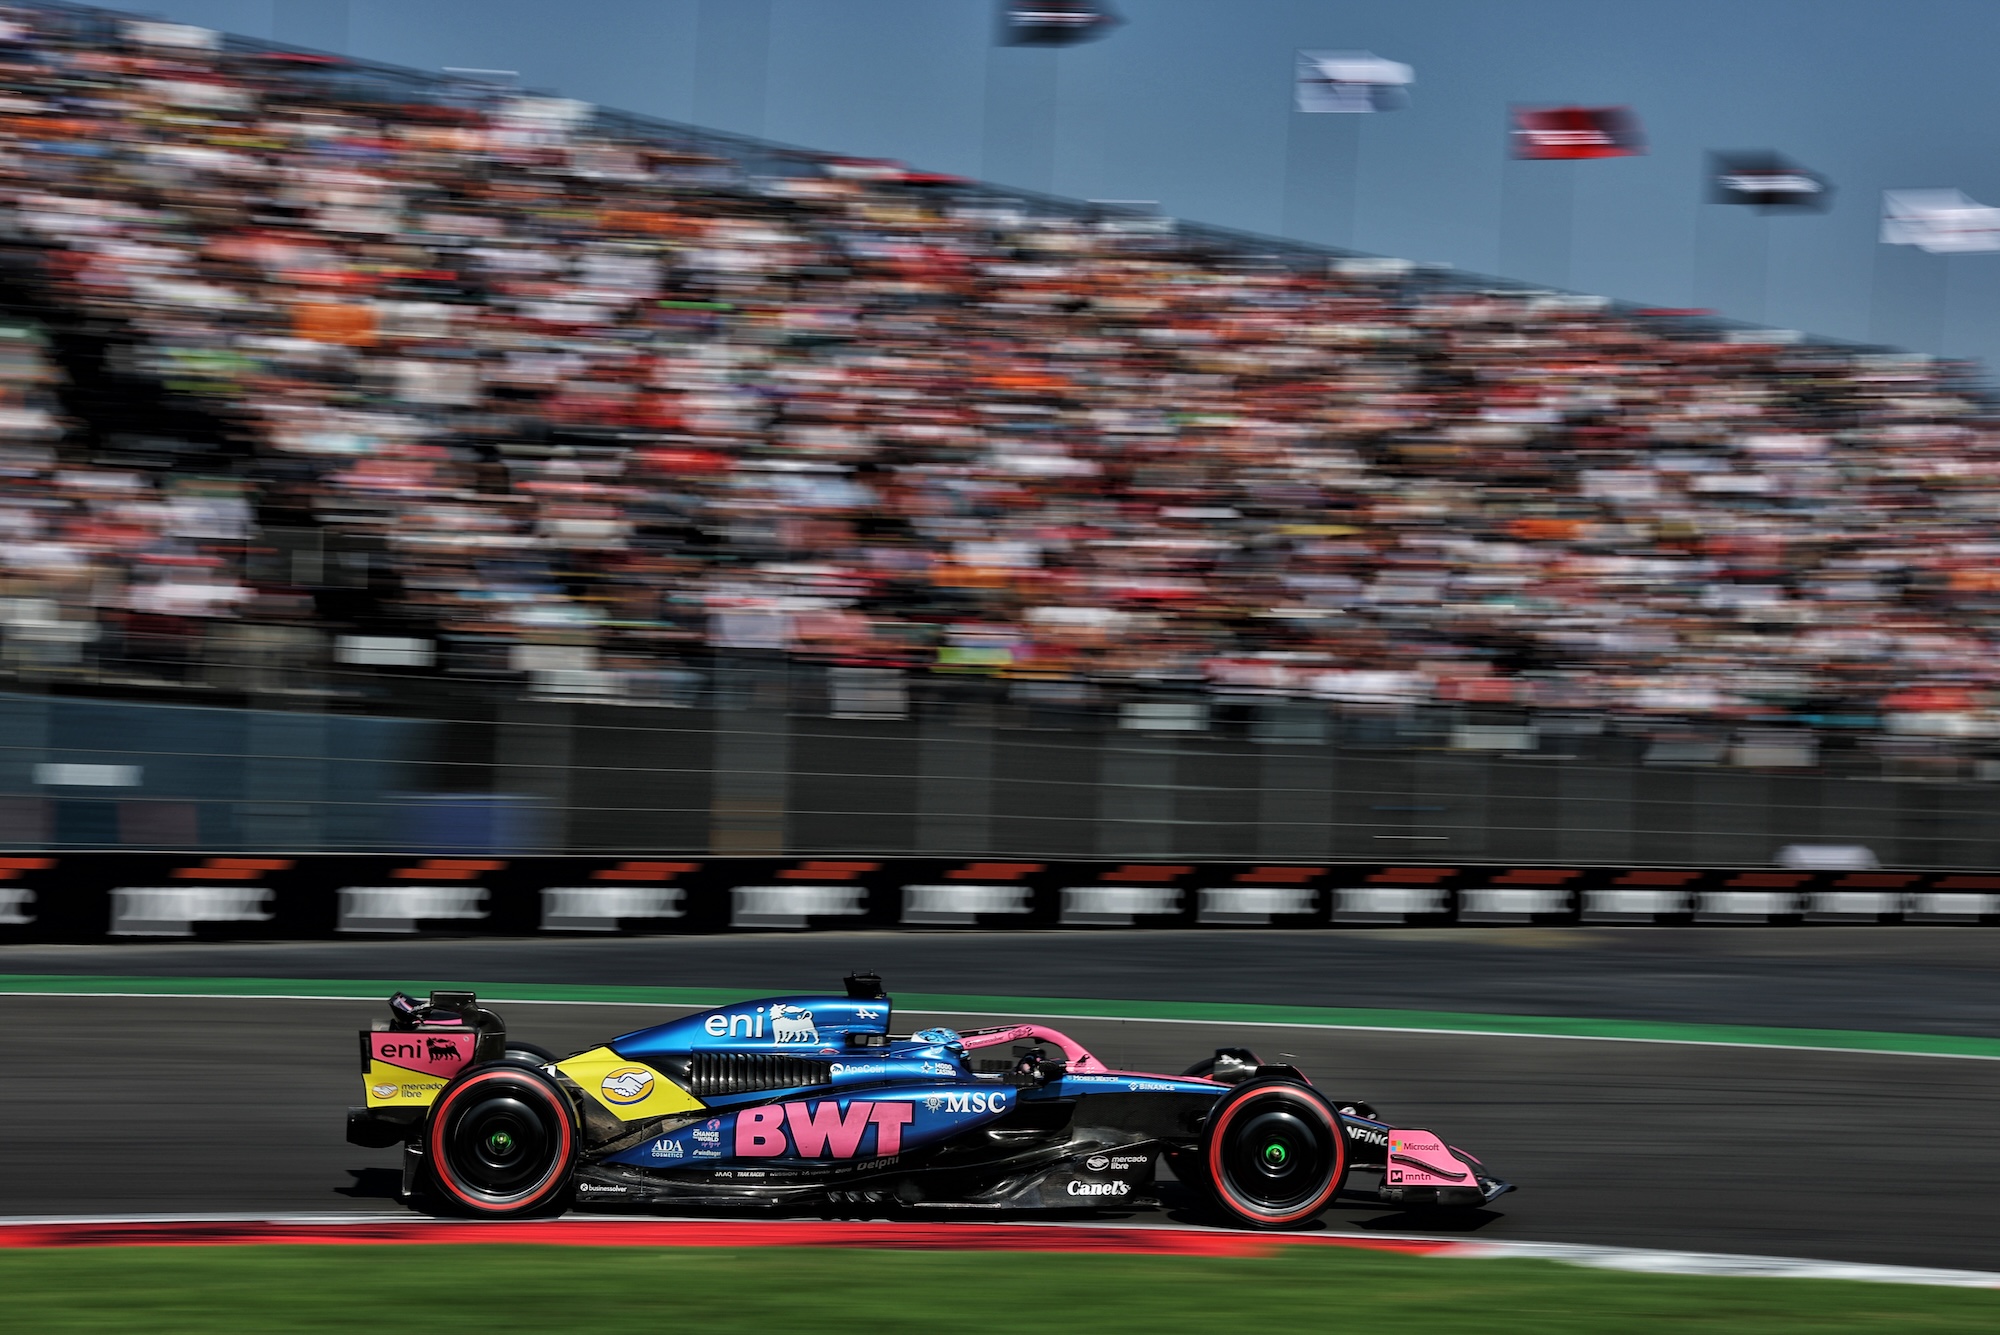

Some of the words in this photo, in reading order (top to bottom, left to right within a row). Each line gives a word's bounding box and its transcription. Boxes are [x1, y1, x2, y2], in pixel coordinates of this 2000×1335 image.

[704, 1007, 766, 1038] eni
[381, 1040, 421, 1058] eni
[845, 1064, 886, 1074] ApeCoin
[1139, 1082, 1175, 1091] BINANCE
[401, 1090, 422, 1098] libre
[945, 1092, 1006, 1113] MSC
[735, 1101, 913, 1158] BWT
[651, 1139, 684, 1151] ADA
[1403, 1142, 1439, 1151] Microsoft
[857, 1156, 900, 1171] Delphi
[1111, 1155, 1147, 1163] mercado
[1110, 1162, 1129, 1170] libre
[589, 1184, 627, 1192] businessolver
[1067, 1180, 1129, 1196] Canel's
